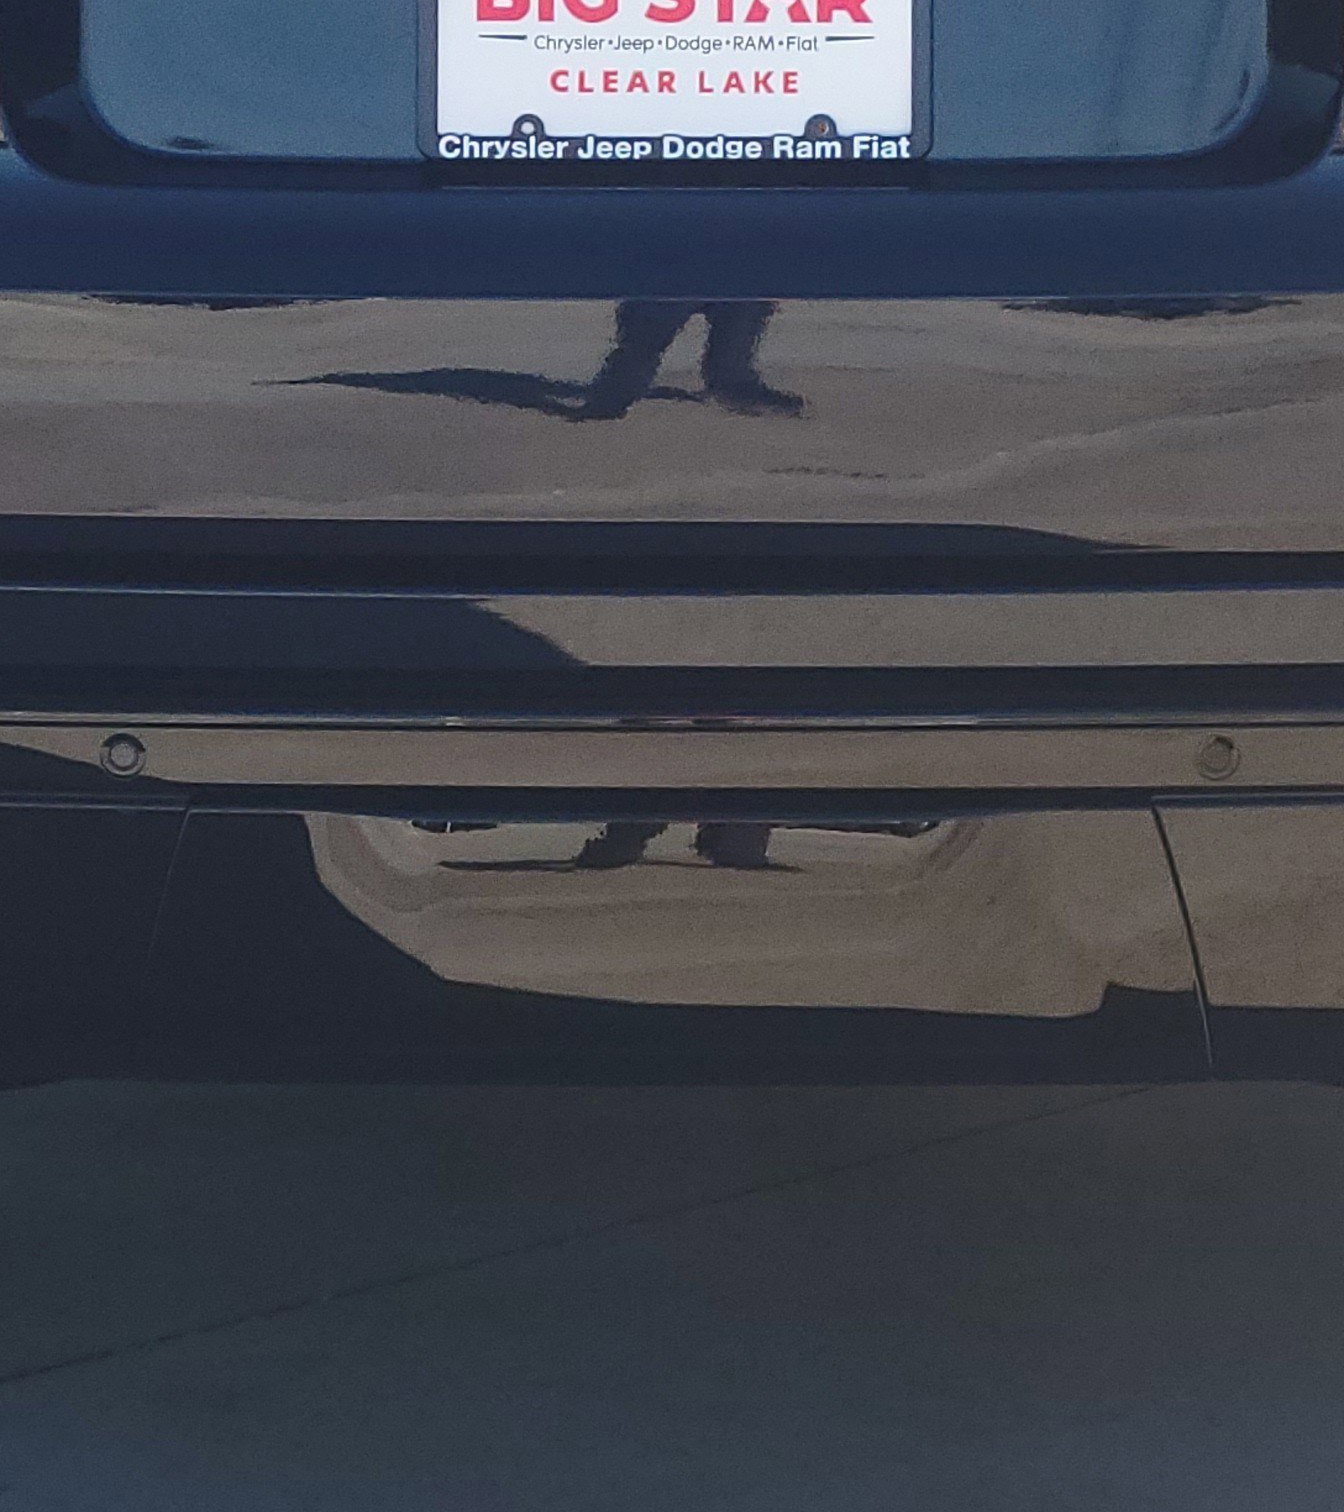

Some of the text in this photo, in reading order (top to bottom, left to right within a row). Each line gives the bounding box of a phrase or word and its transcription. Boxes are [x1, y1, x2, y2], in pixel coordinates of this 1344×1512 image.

[550, 70, 799, 94] CLEAR LAKE
[438, 134, 910, 159] Chrysler Jeep Dodge Ram Fiat
